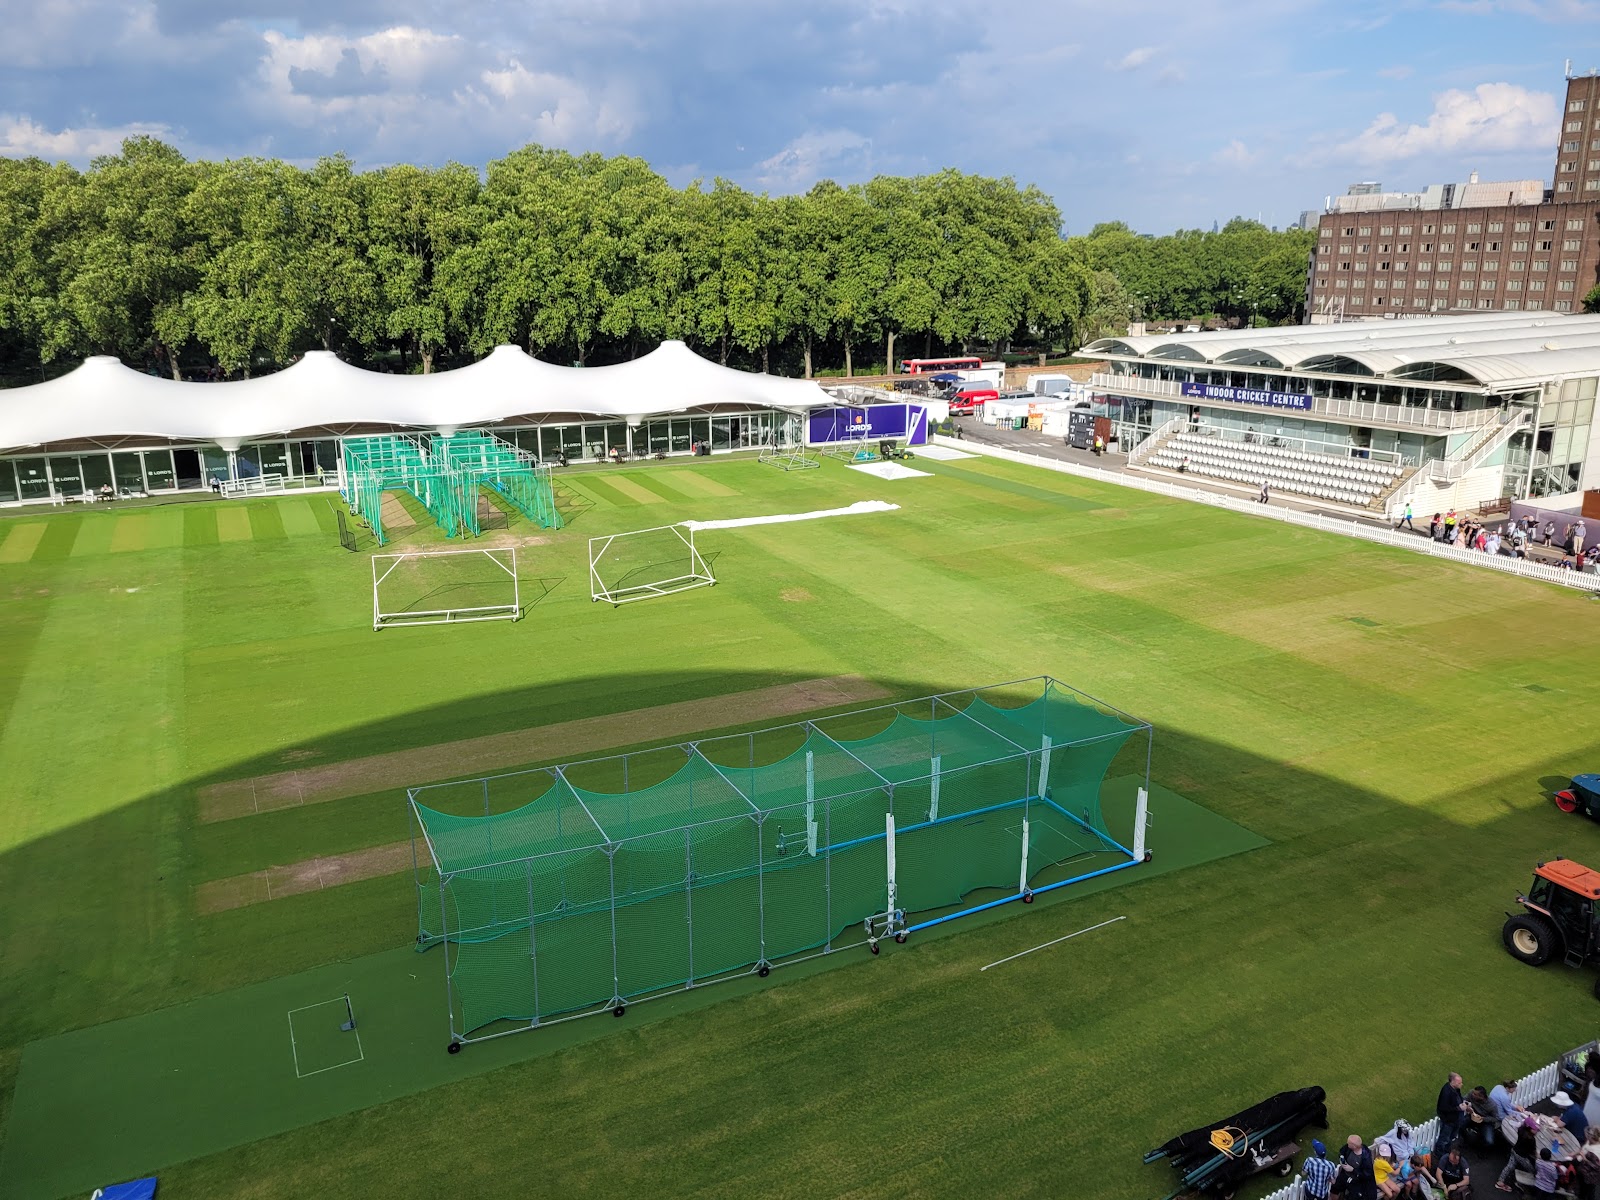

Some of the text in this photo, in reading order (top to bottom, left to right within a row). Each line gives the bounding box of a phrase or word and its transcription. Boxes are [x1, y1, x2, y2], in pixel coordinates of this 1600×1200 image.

[1206, 386, 1305, 406] INDOOR CRICKET CENTRE
